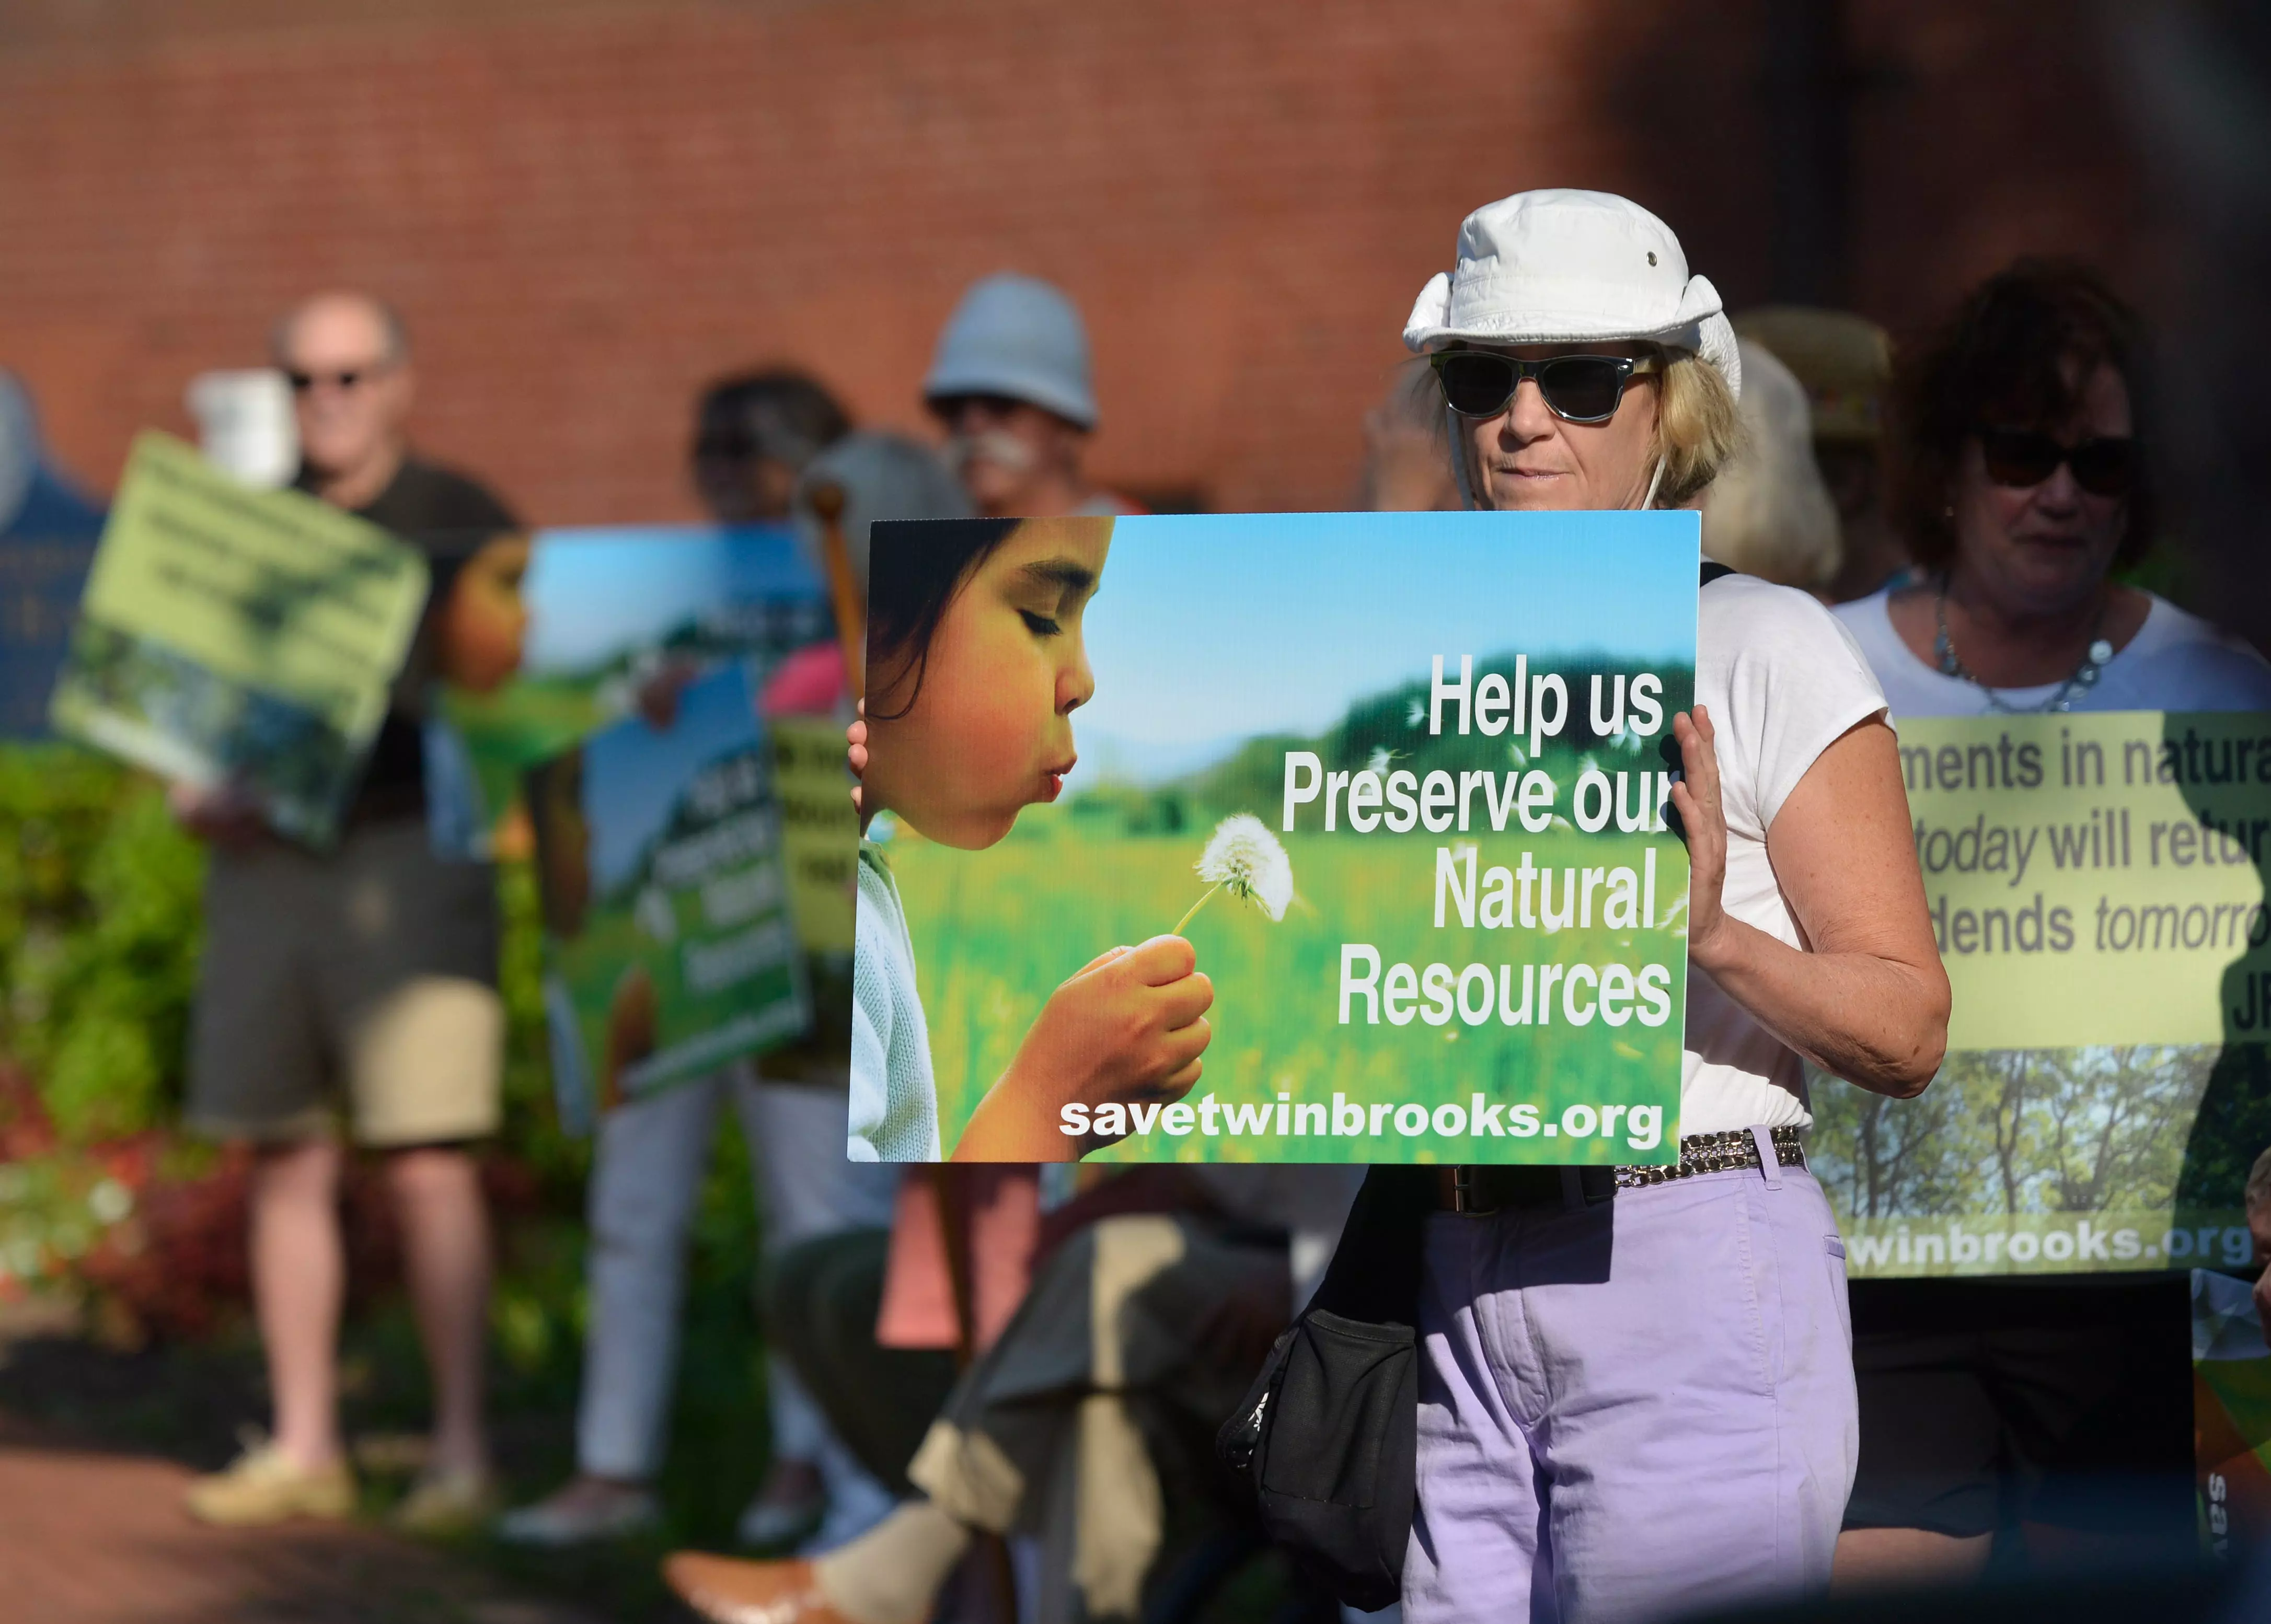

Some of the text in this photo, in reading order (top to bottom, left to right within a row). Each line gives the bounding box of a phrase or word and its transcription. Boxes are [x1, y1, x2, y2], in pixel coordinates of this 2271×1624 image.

[1430, 655, 1663, 757] Help us
[1283, 751, 1680, 833] Preserve our
[2062, 727, 2105, 786] in
[1916, 813, 2038, 887] today
[2048, 807, 2131, 869] will
[1434, 847, 1656, 930] Natural
[1338, 944, 1671, 1027] Resources
[1059, 1092, 1662, 1150] savetwinbrooks.org
